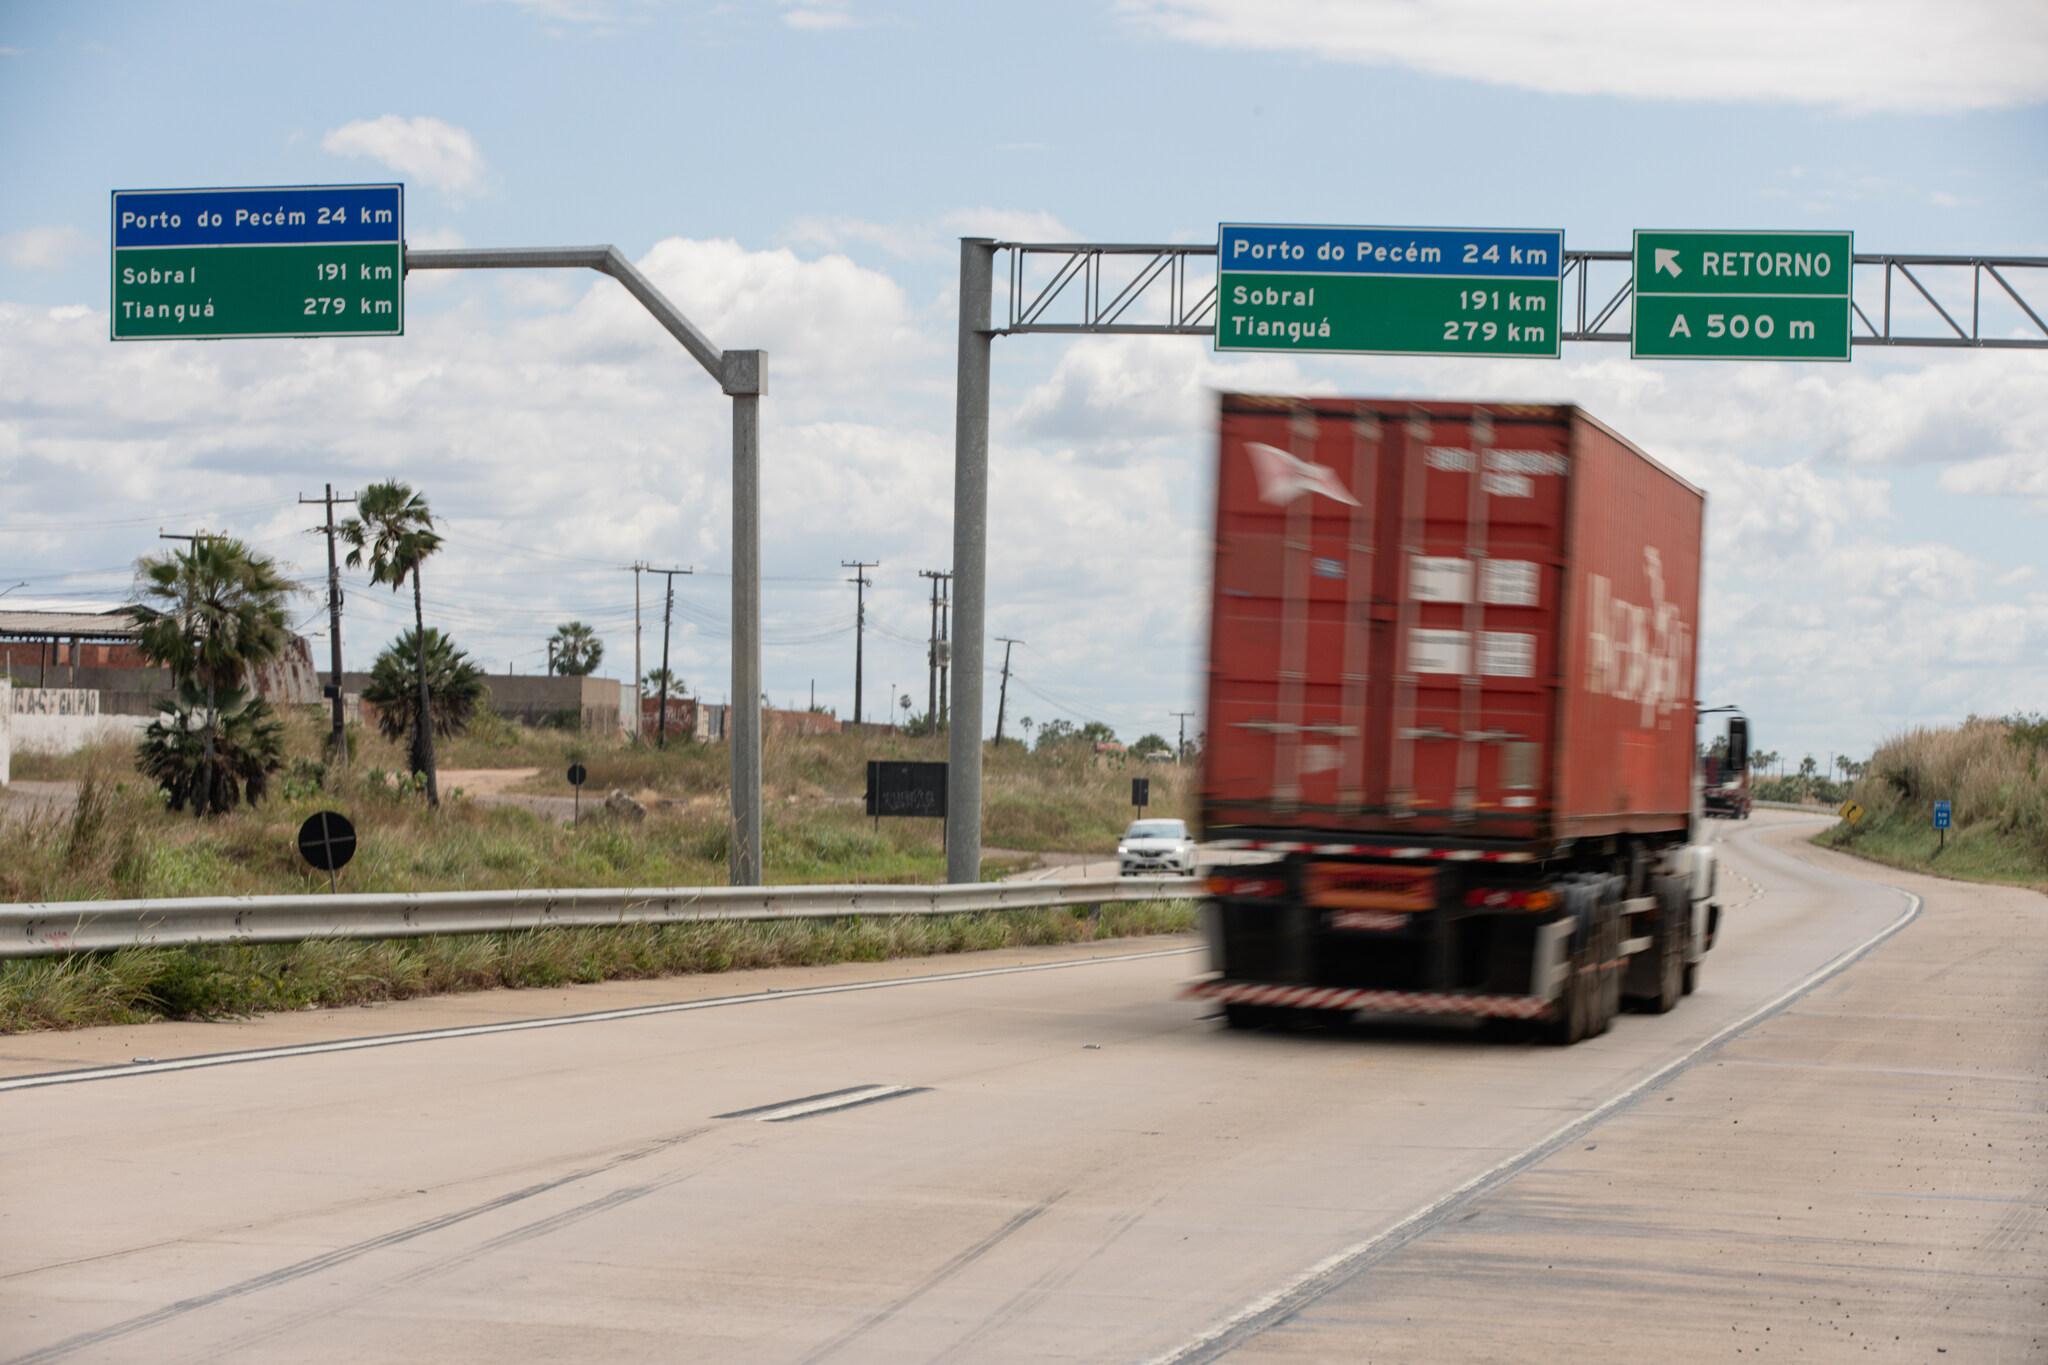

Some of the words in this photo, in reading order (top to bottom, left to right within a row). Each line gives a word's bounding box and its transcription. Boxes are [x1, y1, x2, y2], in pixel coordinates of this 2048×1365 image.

[122, 211, 181, 229] Porto
[197, 210, 222, 227] do
[235, 206, 306, 226] Pecém
[317, 207, 347, 225] 24
[361, 207, 392, 224] km
[1233, 239, 1305, 260] Porto
[1317, 241, 1345, 261] do
[1357, 241, 1441, 263] Pecém
[1462, 243, 1500, 264] 24
[1510, 245, 1547, 265] km
[1702, 251, 1831, 277] RETORNO
[123, 267, 195, 284] Sobral
[317, 263, 347, 281] 191
[360, 263, 392, 280] km
[122, 298, 214, 323] Tianguá
[303, 297, 346, 315] 279
[360, 297, 392, 314] km
[1233, 285, 1314, 306] Sobral
[1460, 290, 1499, 310] 191
[1509, 291, 1546, 311] km
[1231, 316, 1331, 343] Tianguá
[1443, 320, 1498, 341] 279
[1508, 322, 1545, 342] km
[1669, 314, 1692, 338] A
[1707, 314, 1775, 339] 500
[1789, 320, 1815, 339] m
